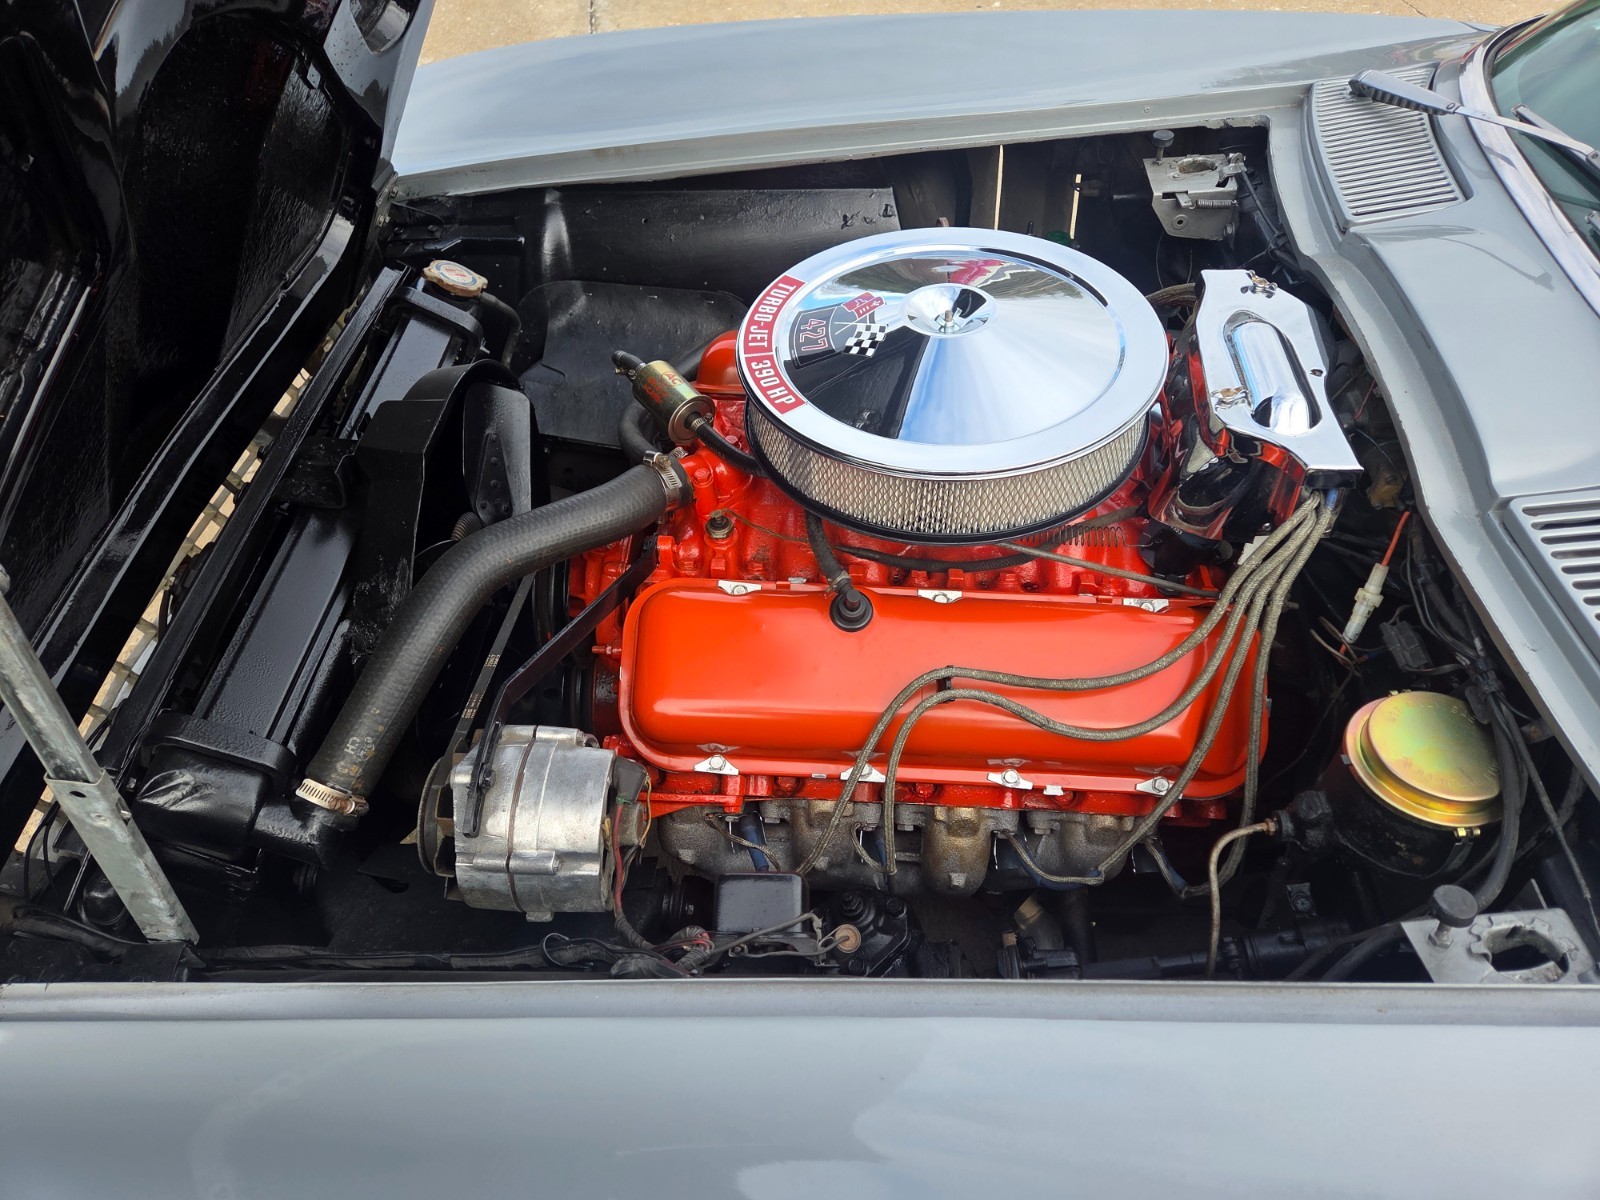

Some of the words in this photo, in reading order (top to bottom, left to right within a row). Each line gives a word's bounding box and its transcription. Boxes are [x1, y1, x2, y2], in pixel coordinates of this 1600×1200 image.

[748, 282, 797, 348] TURBO-JET
[799, 318, 829, 351] 427
[664, 371, 685, 385] AC
[750, 359, 780, 387] 390
[766, 385, 796, 405] HP
